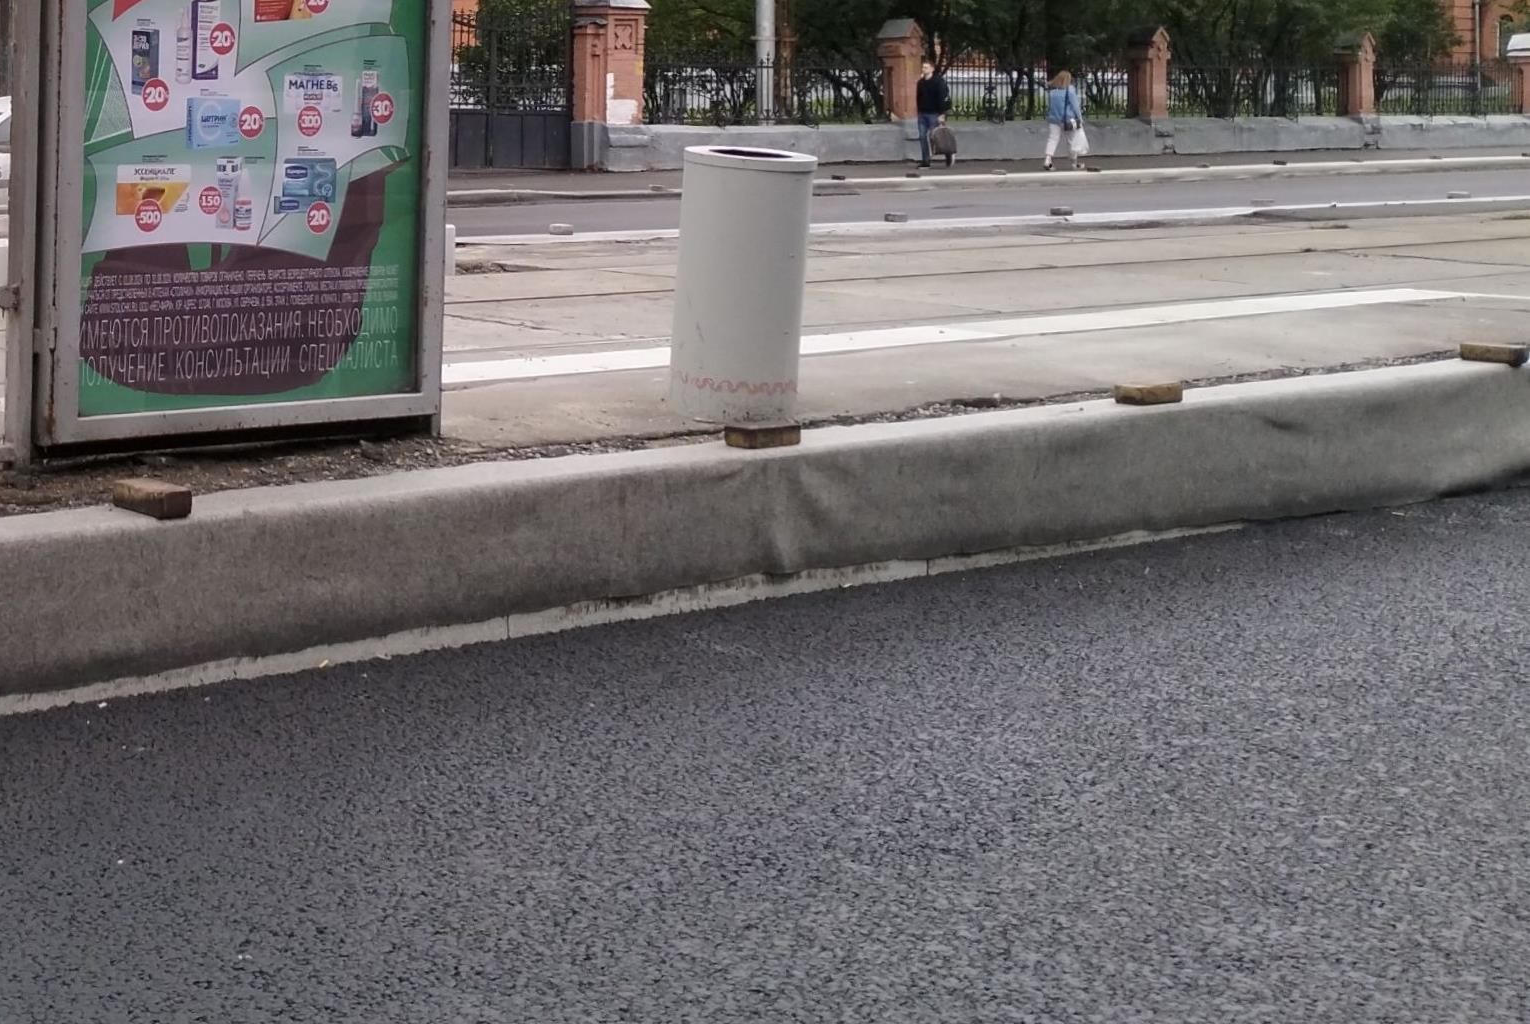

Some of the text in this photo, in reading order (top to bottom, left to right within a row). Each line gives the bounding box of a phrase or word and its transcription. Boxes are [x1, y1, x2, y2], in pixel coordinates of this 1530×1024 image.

[153, 310, 305, 345] ПРОТИВОПОКАЗАНИЯ.
[308, 305, 399, 339] НЕОБХОДИМО
[175, 345, 291, 380] КОНСУЛЬТАЦИИ
[298, 339, 399, 374] СПЕЦИАЛИСТА
